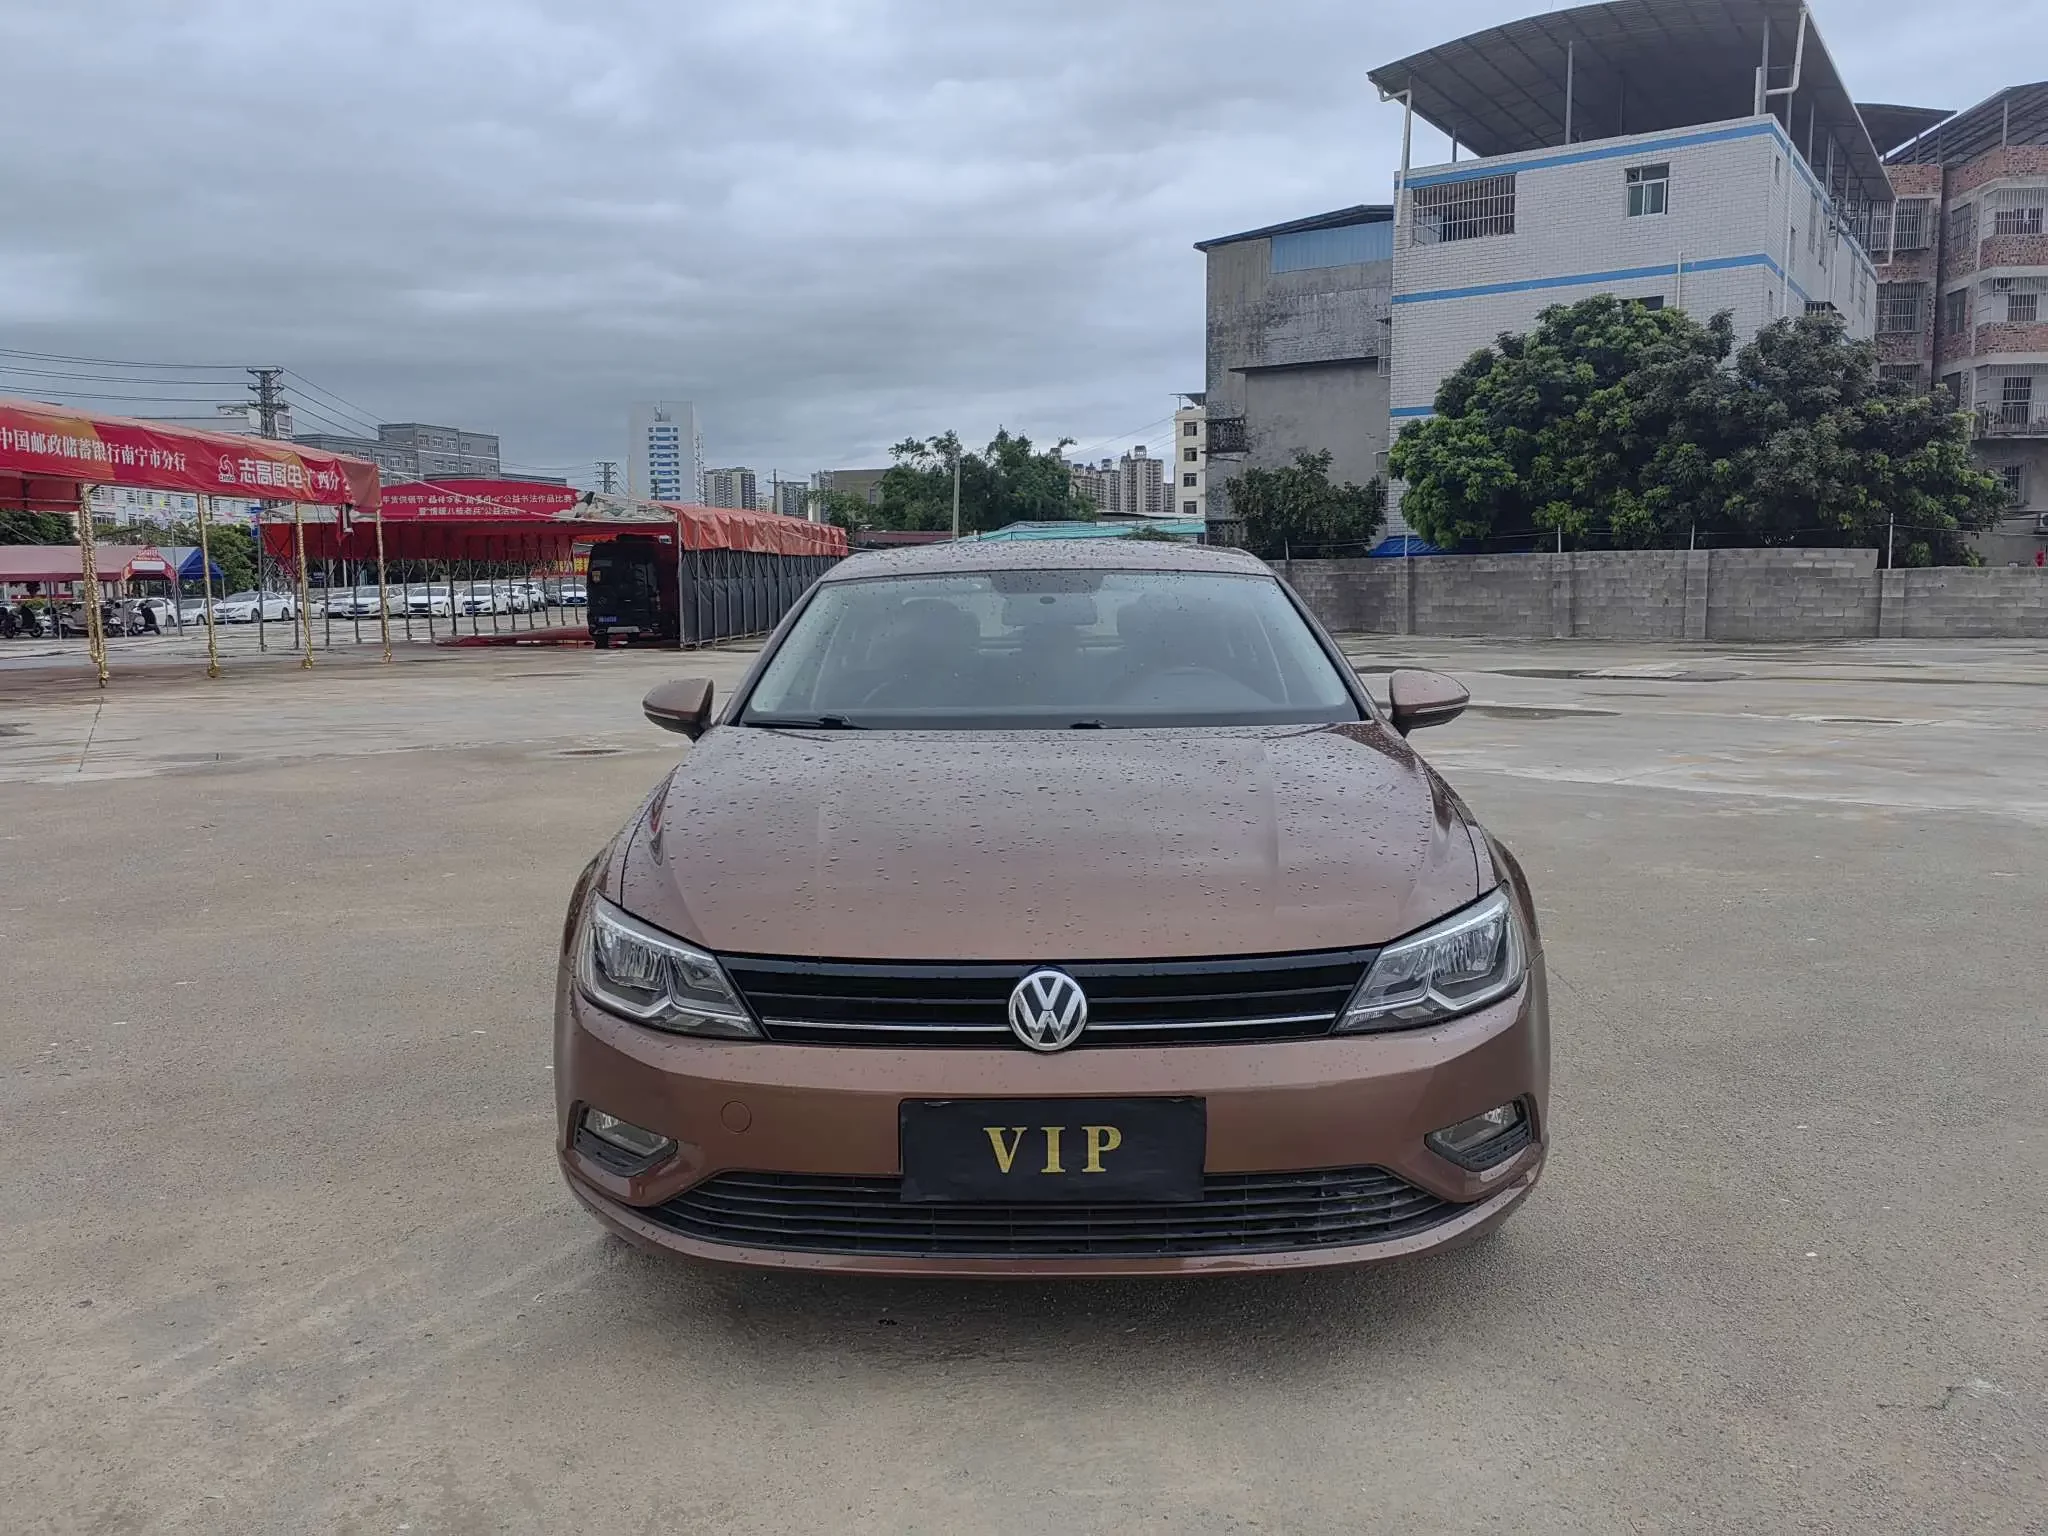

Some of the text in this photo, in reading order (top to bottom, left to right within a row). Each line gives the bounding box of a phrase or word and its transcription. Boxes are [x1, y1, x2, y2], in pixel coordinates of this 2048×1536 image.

[0, 426, 187, 472] 中国邮政储蓄银行南宁市分行
[238, 457, 302, 488] 志高厨电
[983, 1126, 1122, 1173] VIP
